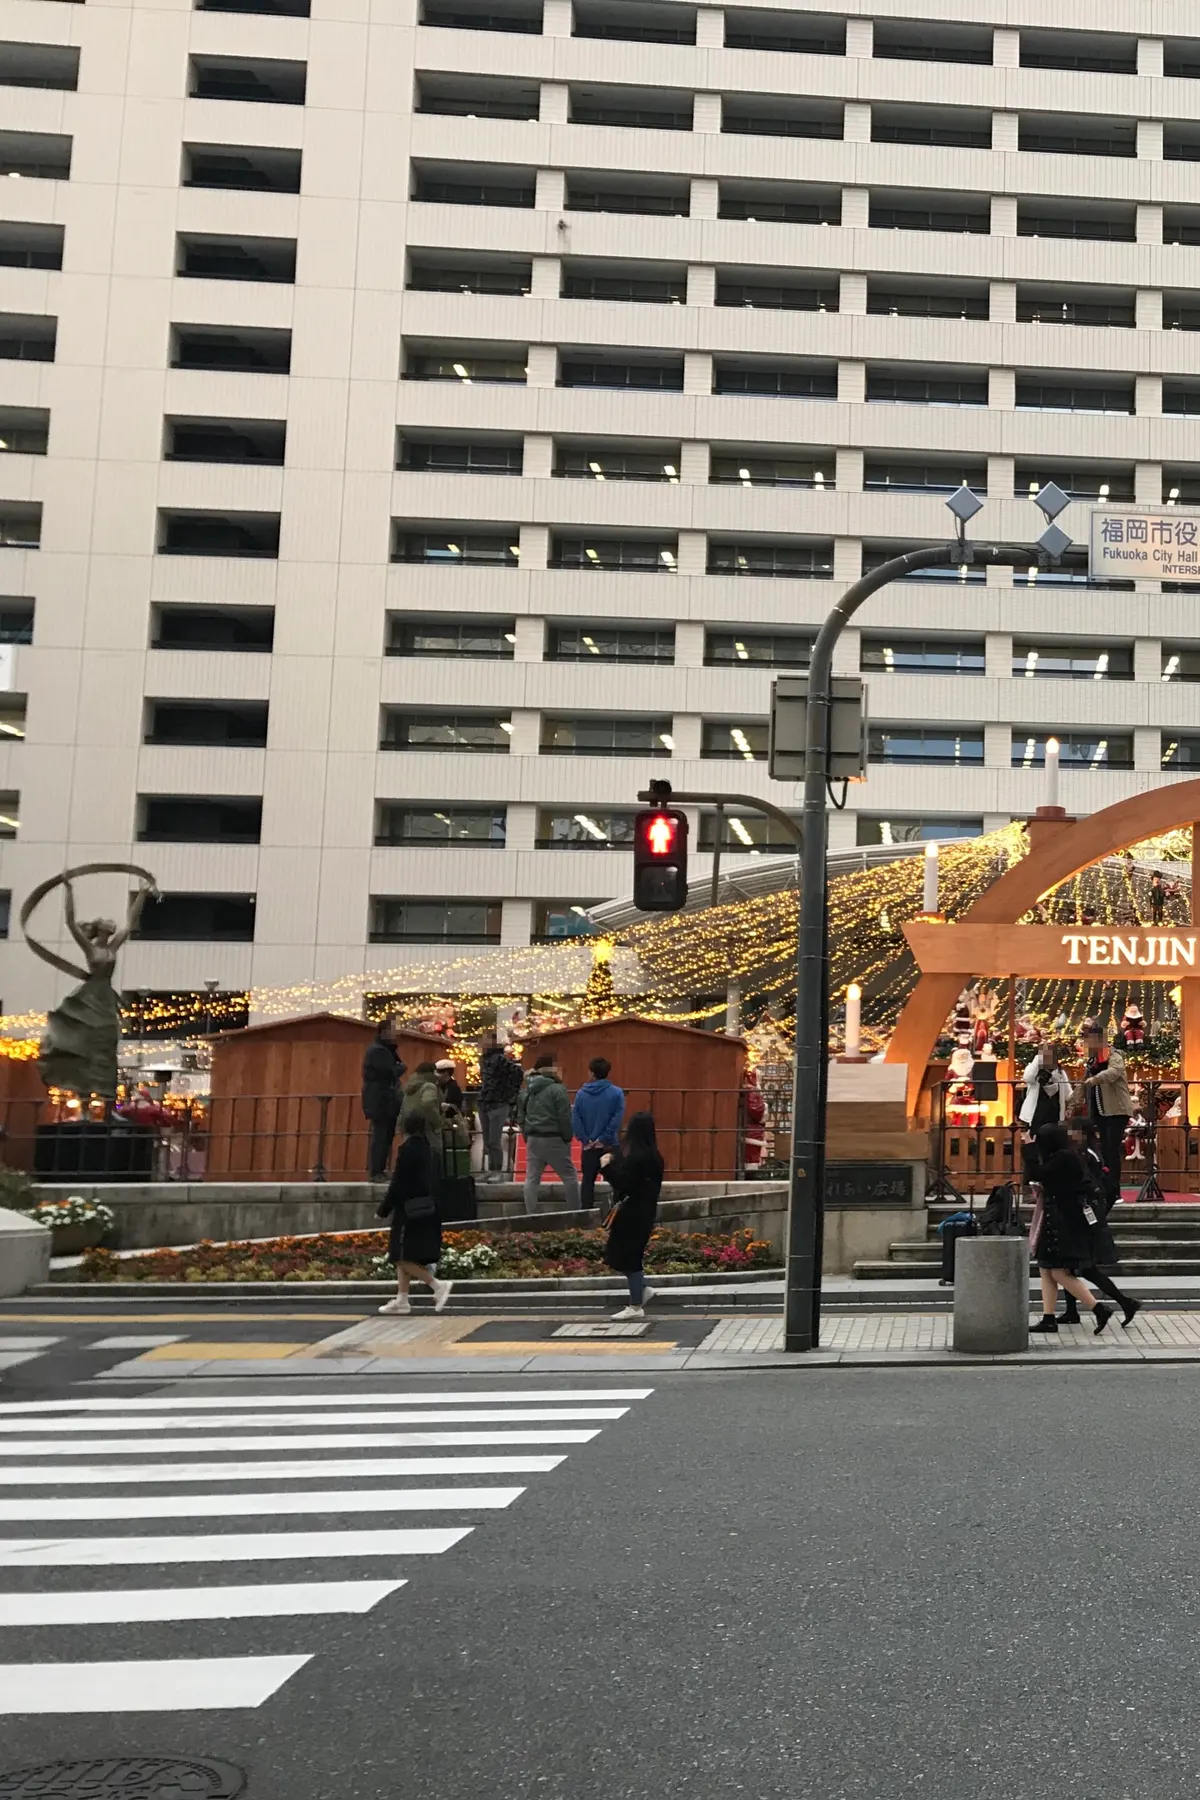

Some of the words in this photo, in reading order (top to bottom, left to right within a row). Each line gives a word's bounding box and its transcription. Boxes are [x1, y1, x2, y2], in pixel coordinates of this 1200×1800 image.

[1102, 547, 1148, 562] Fukuoka
[1152, 549, 1173, 564] City
[1177, 551, 1198, 563] Hall
[1061, 934, 1197, 967] TENJIN
